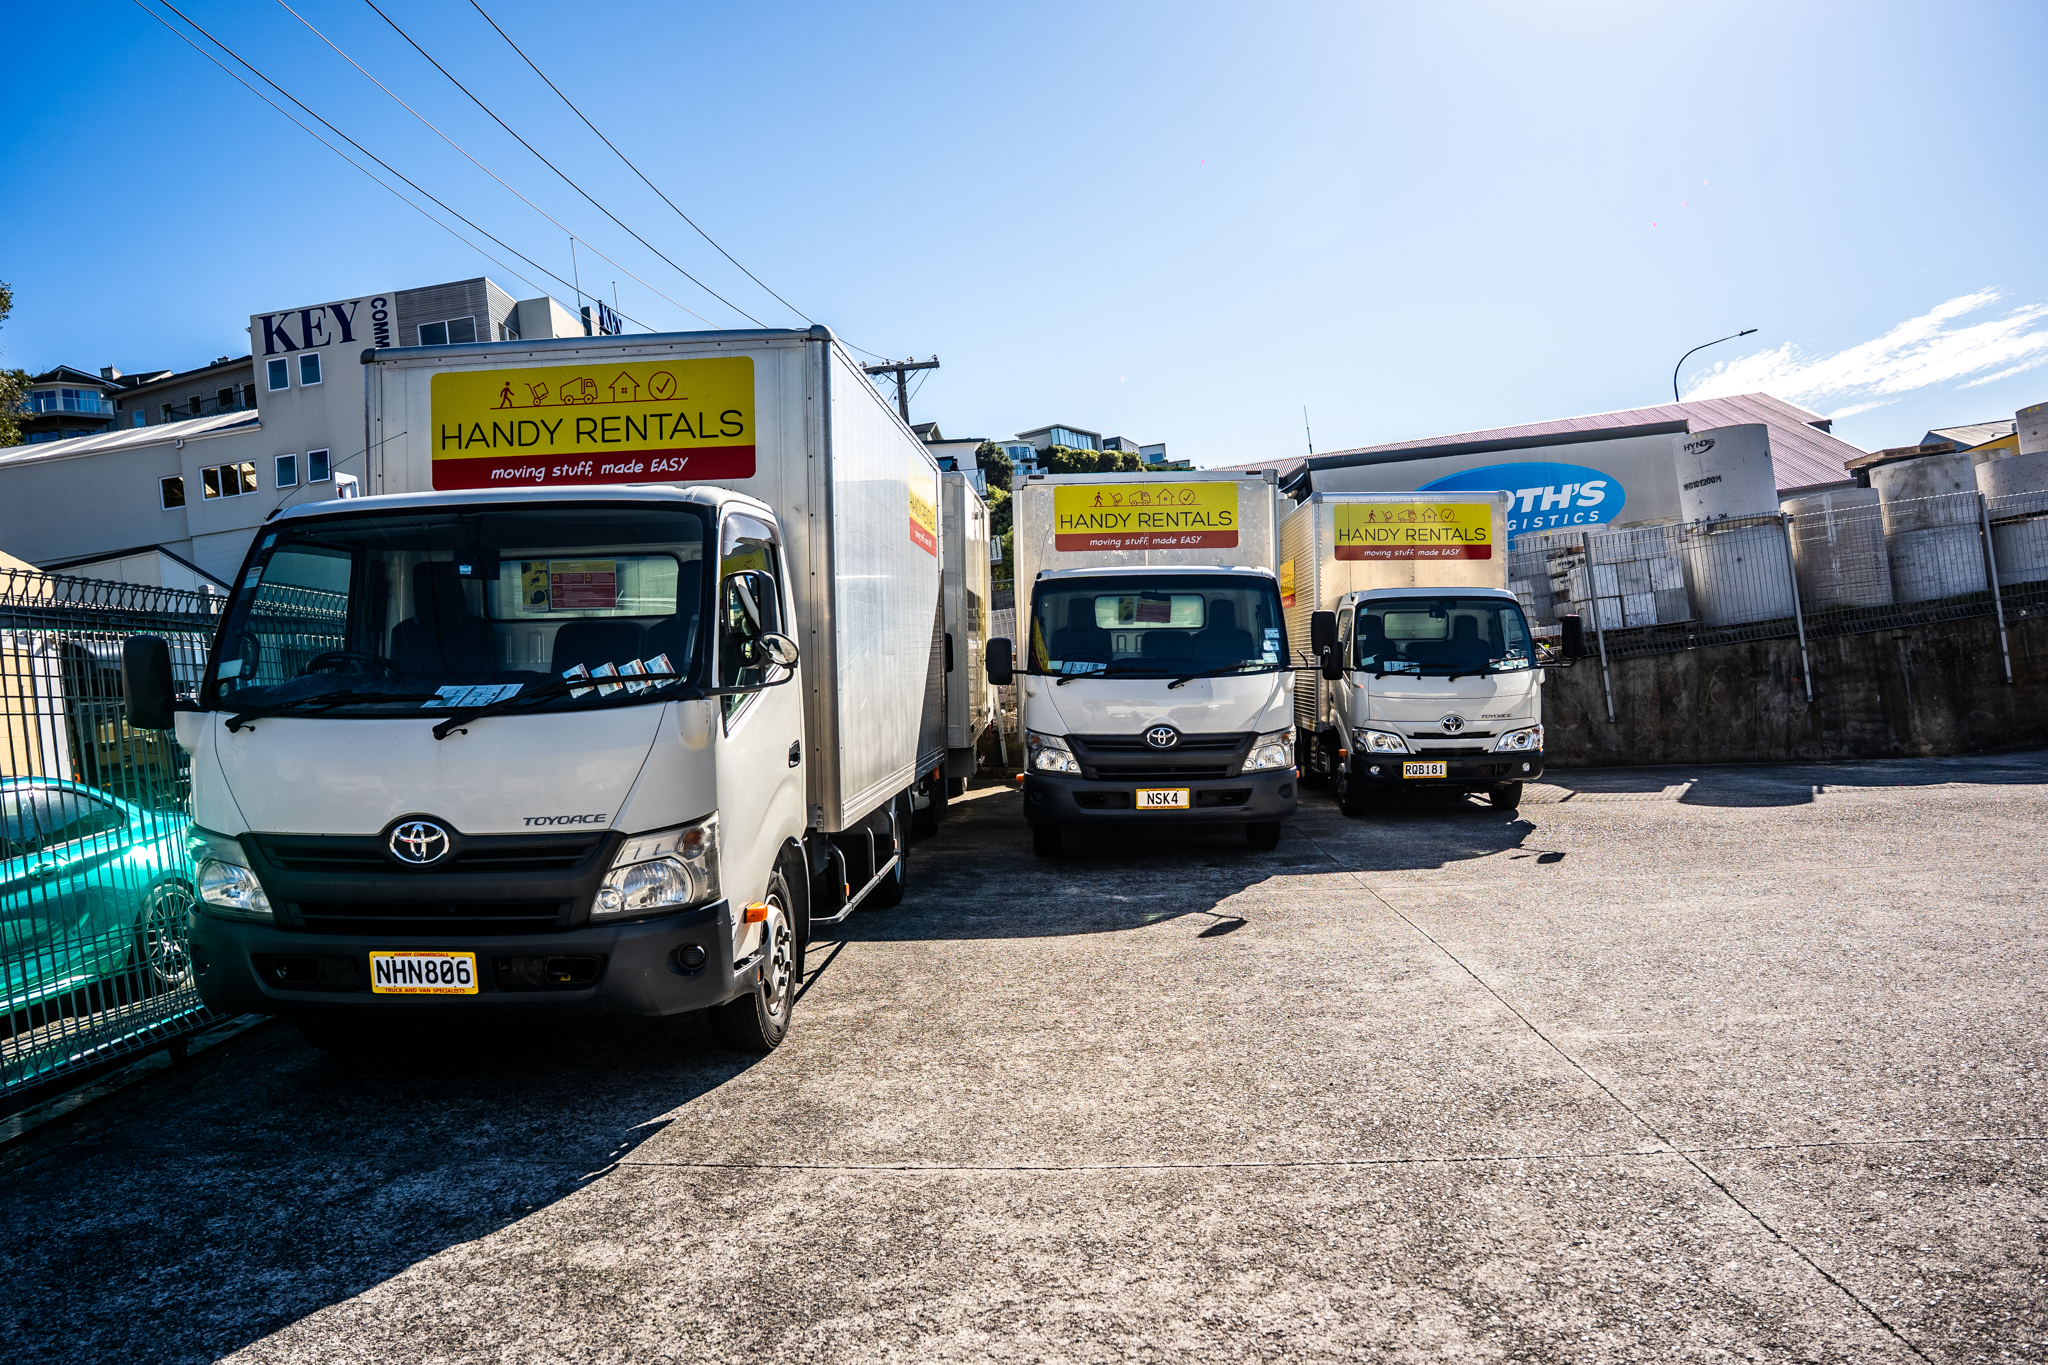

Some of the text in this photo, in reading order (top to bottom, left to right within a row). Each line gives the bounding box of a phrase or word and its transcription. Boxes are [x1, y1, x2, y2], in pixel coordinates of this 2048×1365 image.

[258, 300, 361, 356] KEY
[441, 409, 744, 450] HANDY RENTALS
[1683, 438, 1715, 451] HYNDS
[490, 456, 688, 482] moving stuff, made EASY
[1060, 510, 1232, 529] HANDY RENTALS
[1339, 527, 1486, 541] HANDY RENTALS
[1089, 537, 1121, 548] moving
[1152, 536, 1177, 545] made
[1181, 535, 1202, 544] EASY
[1364, 550, 1391, 558] moving
[1442, 548, 1460, 556] EASY
[1405, 764, 1443, 775] RQB181
[1147, 792, 1178, 805] NSK4
[523, 813, 607, 826] TOYOACE
[375, 959, 471, 985] NHN806
